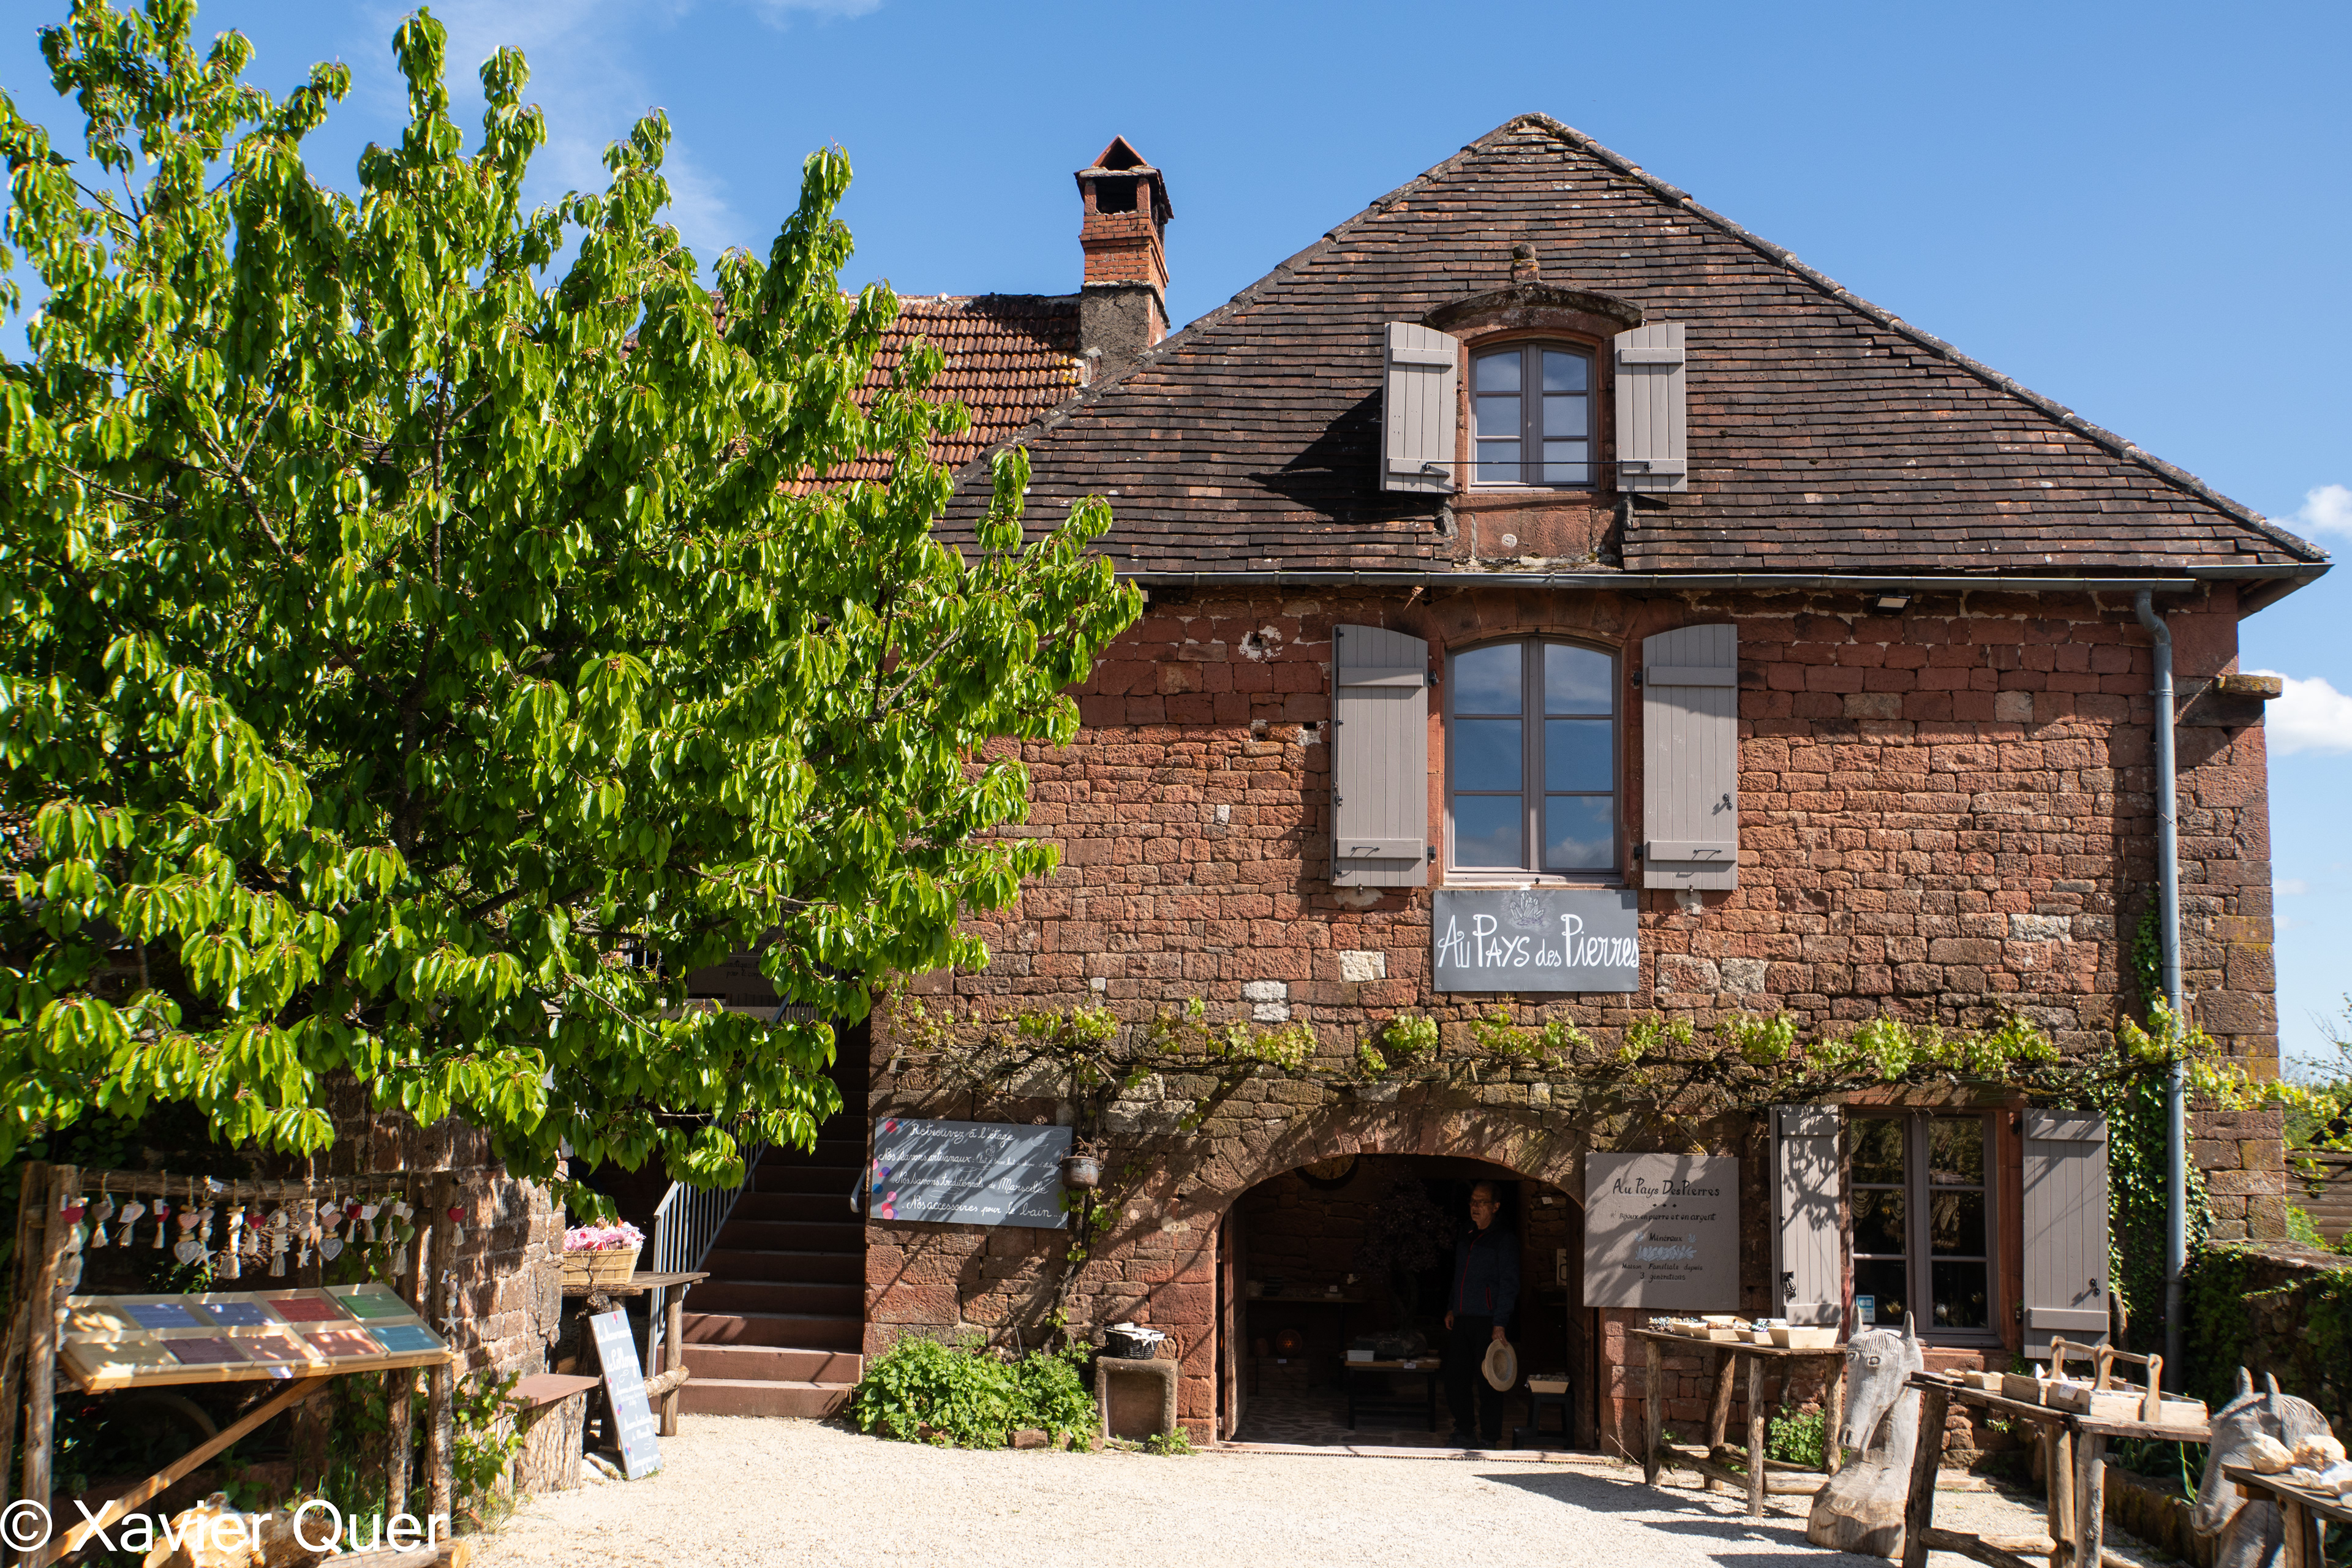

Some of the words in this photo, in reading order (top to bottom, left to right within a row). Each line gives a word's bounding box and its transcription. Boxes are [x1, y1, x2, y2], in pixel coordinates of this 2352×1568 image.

[1536, 938, 1561, 967] des
[1561, 914, 1640, 968] Pierres
[910, 1123, 964, 1144] Retrouvez
[969, 1128, 978, 1138] à
[978, 1127, 1015, 1148] l'étage
[878, 1147, 896, 1161] Nos
[895, 1171, 910, 1184] Nos
[940, 1173, 984, 1188] traditionnels
[988, 1181, 995, 1189] de
[997, 1177, 1049, 1194] Marseille
[1613, 1178, 1632, 1194] Au
[1636, 1177, 1659, 1198] Pays
[1662, 1180, 1680, 1195] Des
[1681, 1179, 1720, 1196] Pierres
[907, 1195, 925, 1209] Nos
[927, 1202, 978, 1212] accessoires
[981, 1205, 1001, 1216] pour
[1006, 1201, 1015, 1214] le
[1690, 1213, 1716, 1223] argent
[1649, 1232, 1683, 1242] Minéraux
[1684, 1264, 1703, 1272] depuis
[1649, 1273, 1686, 1283] générations
